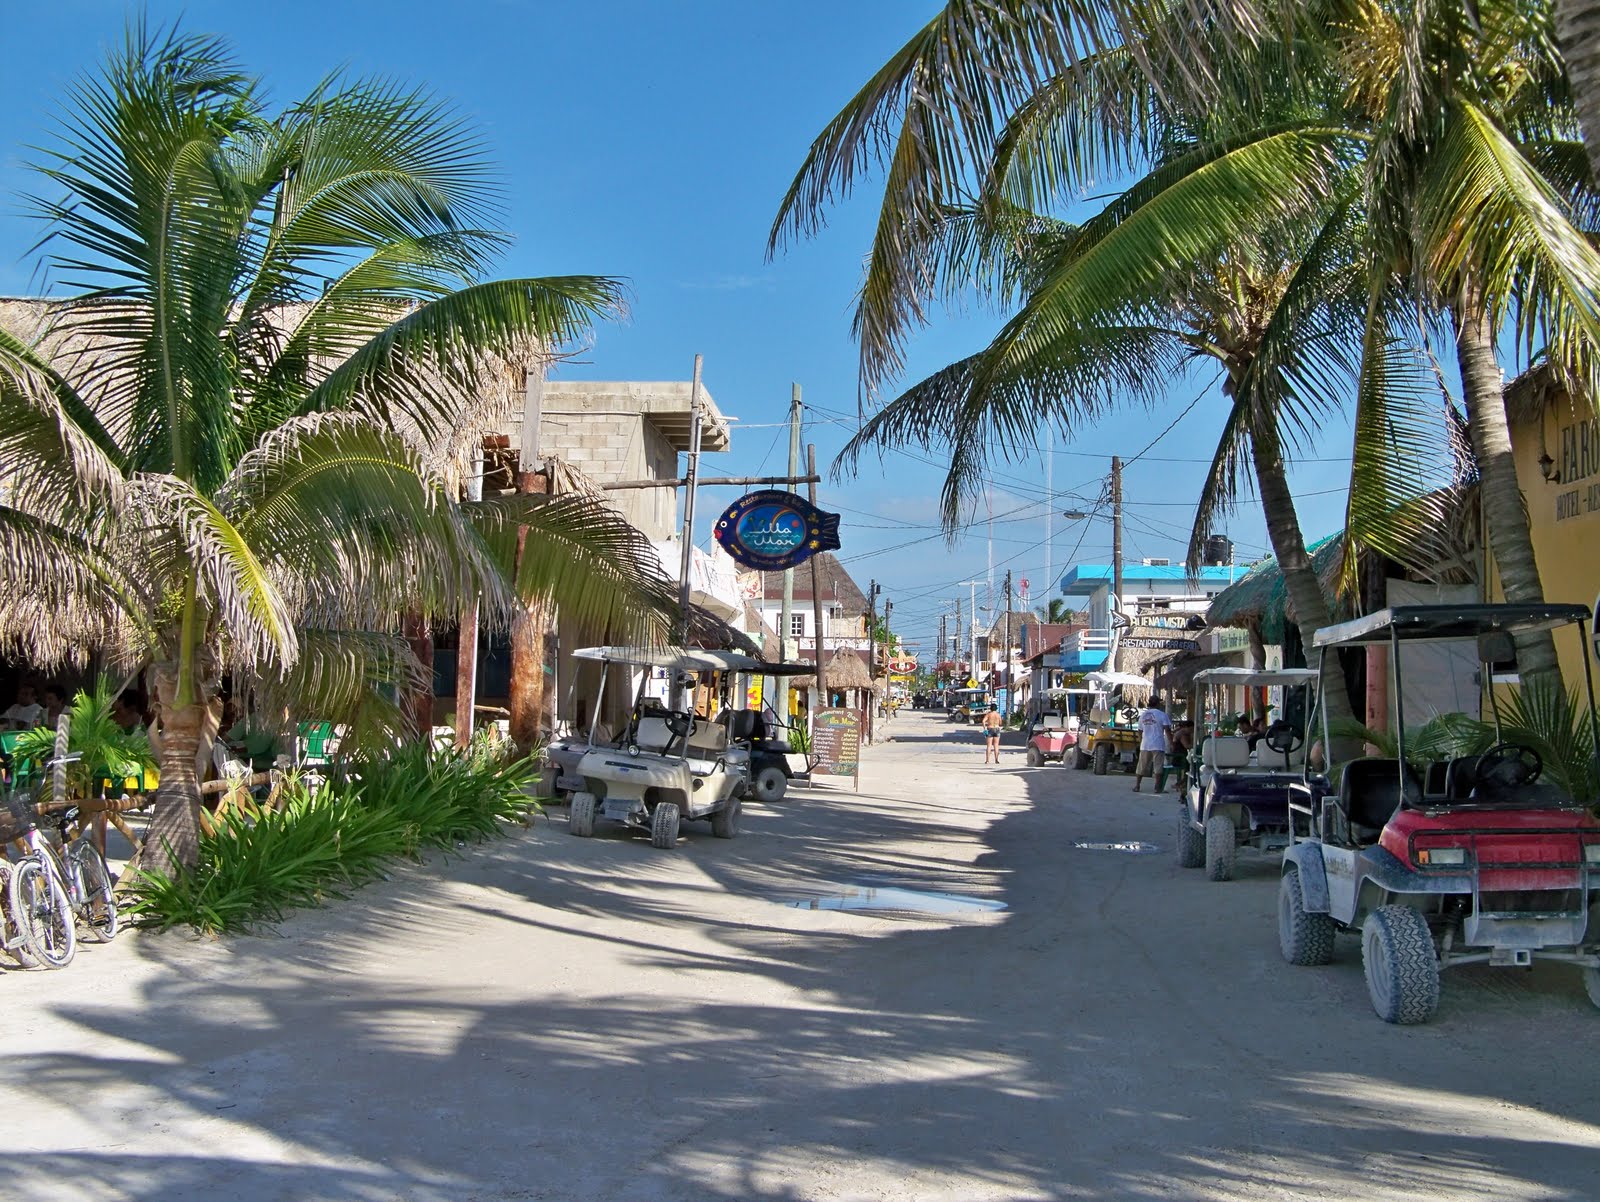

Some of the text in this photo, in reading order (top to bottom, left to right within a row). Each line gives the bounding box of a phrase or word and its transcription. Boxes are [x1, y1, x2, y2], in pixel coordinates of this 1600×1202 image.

[1562, 420, 1600, 485] FARO
[1556, 490, 1580, 522] HOTEL
[1130, 616, 1187, 628] BUENA VISTA
[1122, 639, 1165, 649] RESTAURANT
